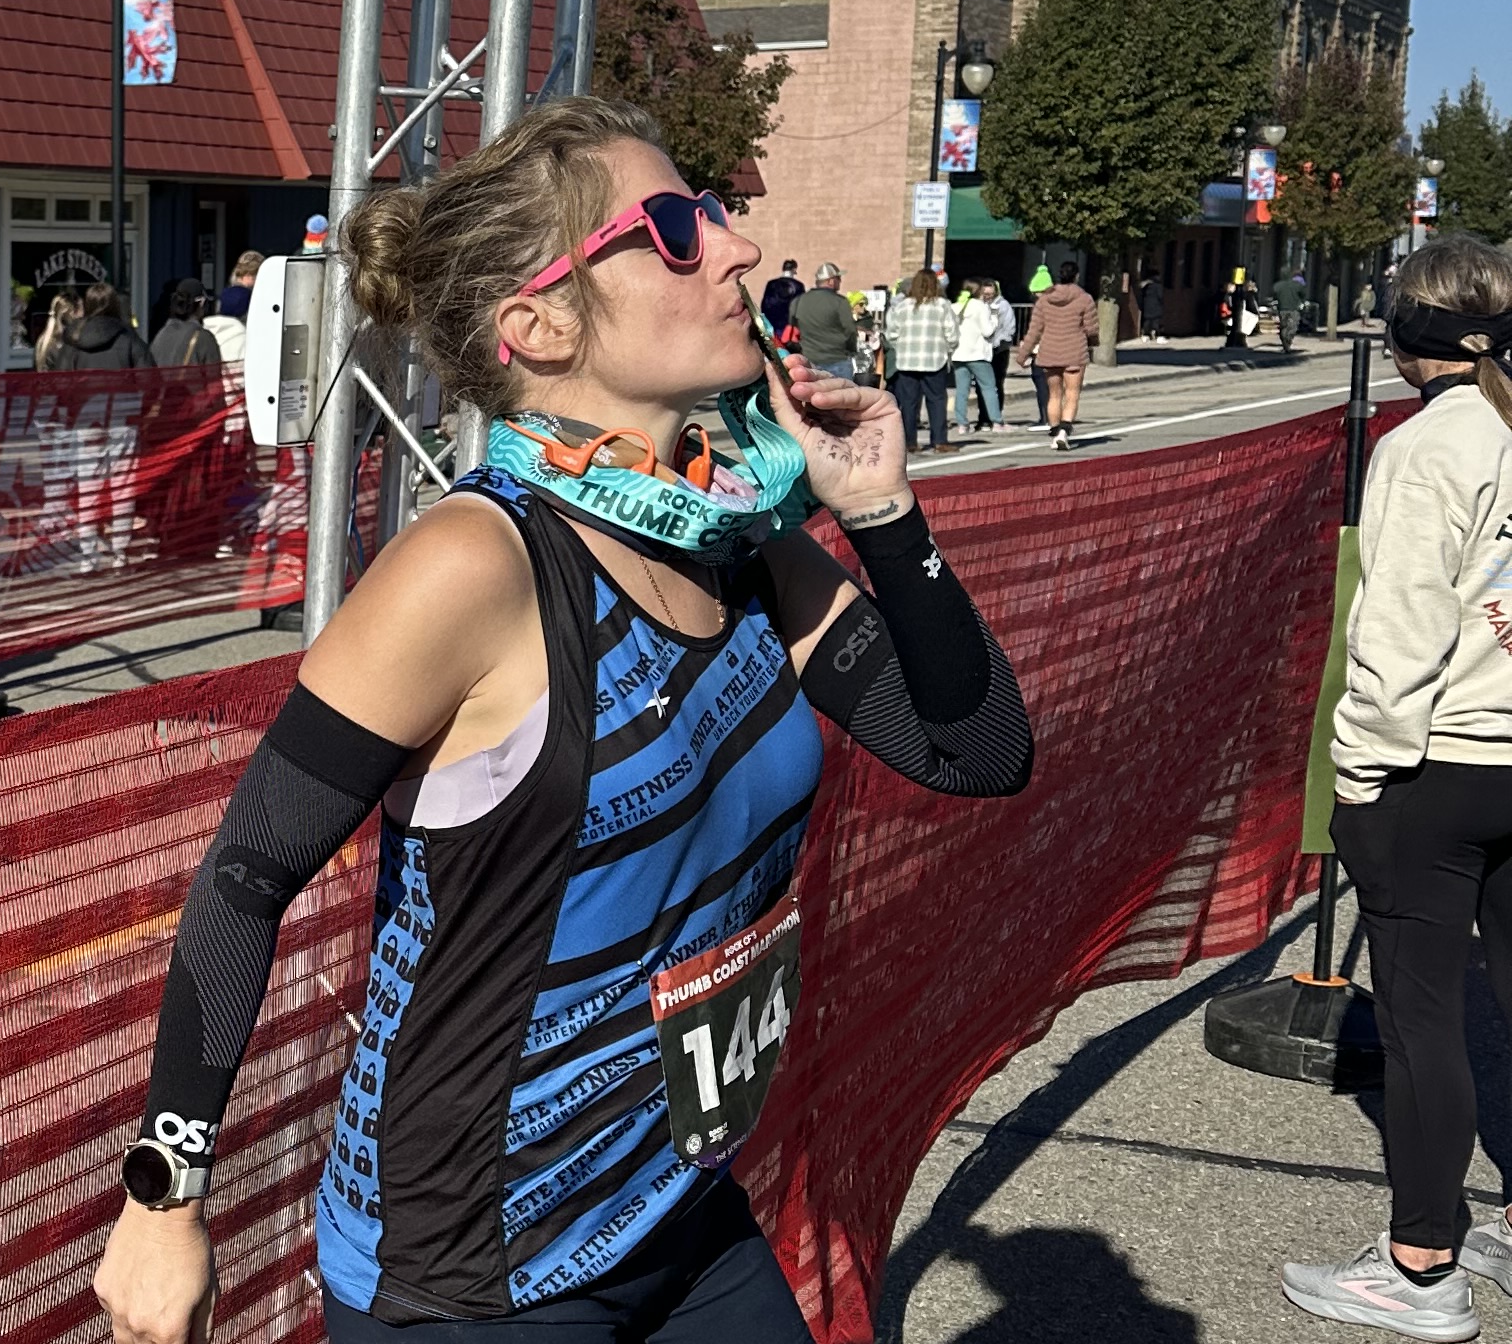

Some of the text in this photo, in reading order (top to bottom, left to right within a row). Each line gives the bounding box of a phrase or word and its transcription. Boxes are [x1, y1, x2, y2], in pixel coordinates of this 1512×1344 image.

[575, 480, 688, 541] THUMB
[658, 487, 745, 530] ROCK CF
[738, 685, 761, 711] YOUR
[607, 752, 694, 817] FITNESS
[689, 708, 718, 760] INNER
[714, 652, 763, 717] ATHLETE
[580, 804, 657, 843] POTENTIAL
[656, 973, 713, 1011] THUMB
[712, 950, 751, 985] COAST
[749, 908, 802, 962] MARATHON
[663, 926, 719, 970] INNER
[724, 939, 744, 958] ROCK
[681, 964, 791, 1113] 144
[554, 1053, 641, 1109] FITNESS
[554, 1114, 637, 1187] FITNESS
[569, 1193, 648, 1268] FITNESS
